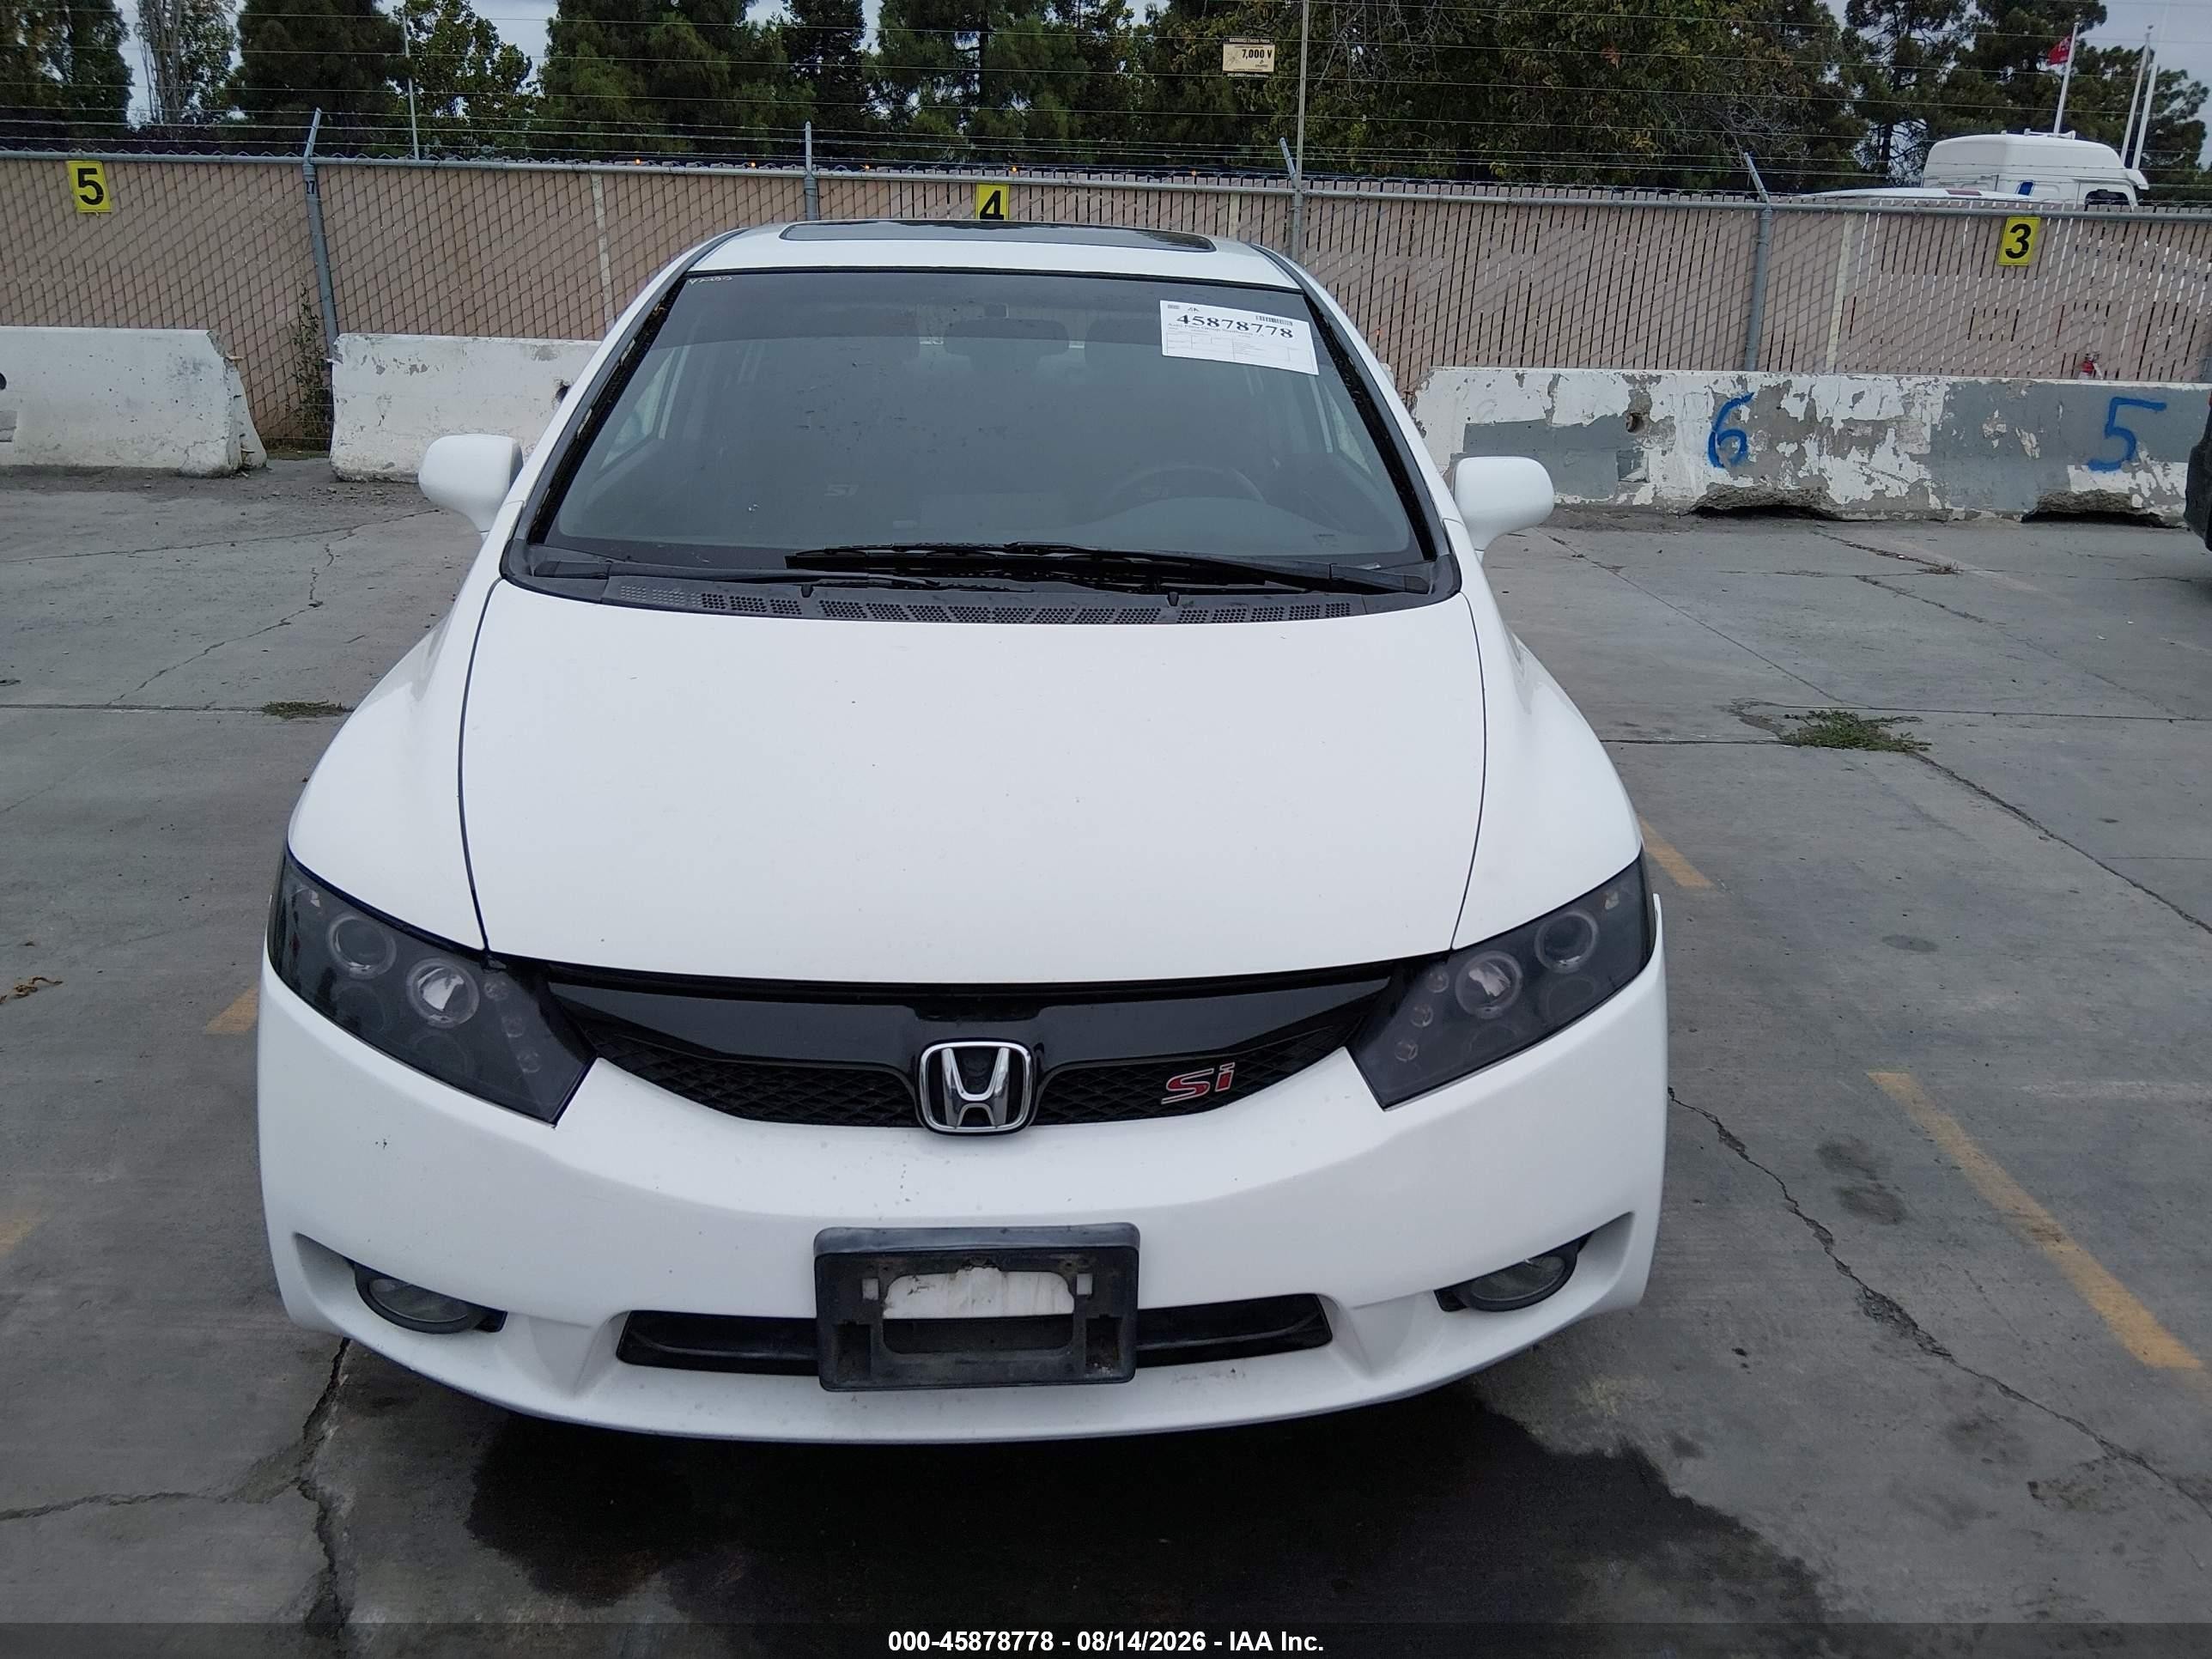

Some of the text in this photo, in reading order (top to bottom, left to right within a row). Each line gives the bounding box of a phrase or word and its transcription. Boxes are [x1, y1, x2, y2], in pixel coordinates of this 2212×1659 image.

[1242, 49, 1273, 59] 7,000 V
[77, 167, 104, 205] 5
[979, 190, 1005, 220] 4
[2005, 223, 2032, 259] 3
[1176, 314, 1294, 338] 45878778
[1707, 392, 1755, 469] 6
[2086, 395, 2168, 472] 5
[1161, 1061, 1236, 1105] Si
